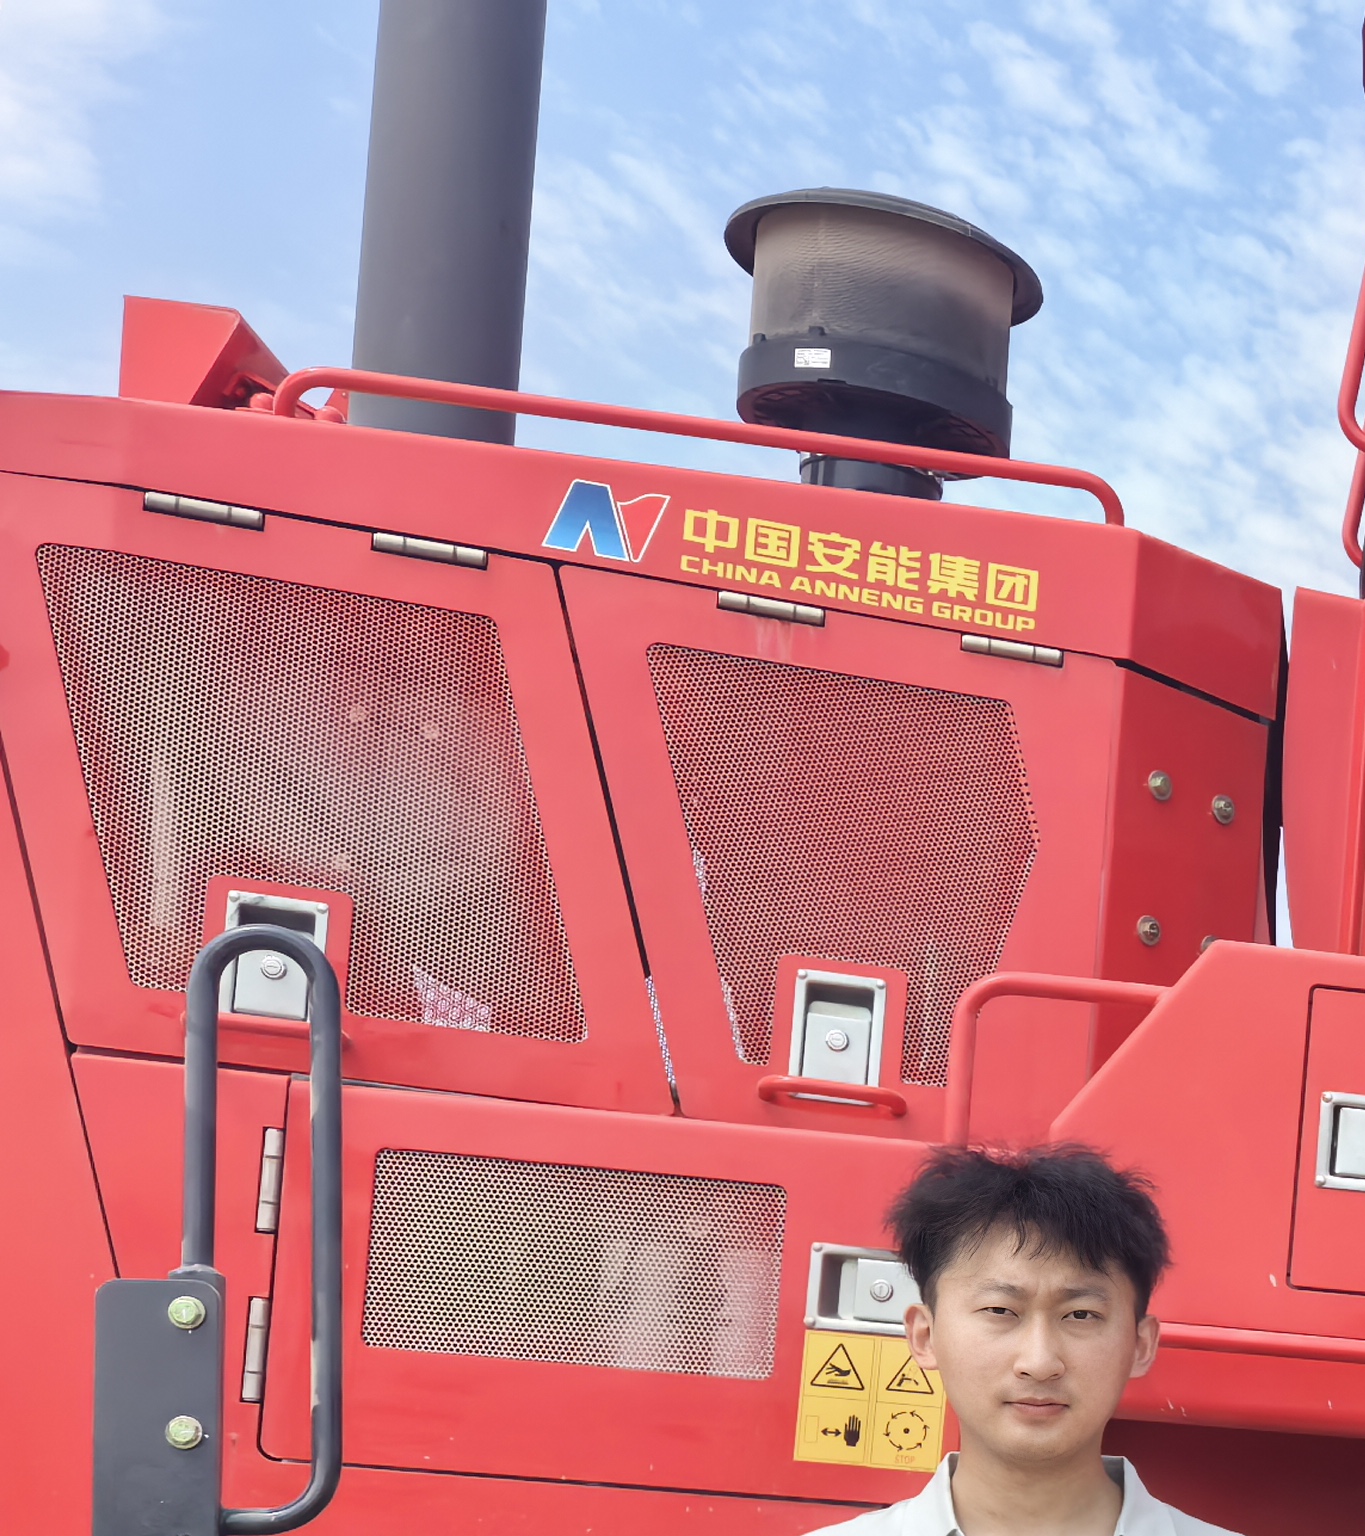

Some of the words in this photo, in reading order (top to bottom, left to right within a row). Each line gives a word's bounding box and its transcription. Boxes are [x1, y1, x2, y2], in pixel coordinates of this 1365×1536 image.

[680, 556, 782, 588] CHINA
[790, 576, 924, 615] ANNENG
[931, 600, 1036, 632] GROUP
[683, 509, 1039, 612] 中国安能集团
[894, 1454, 915, 1464] STOP
